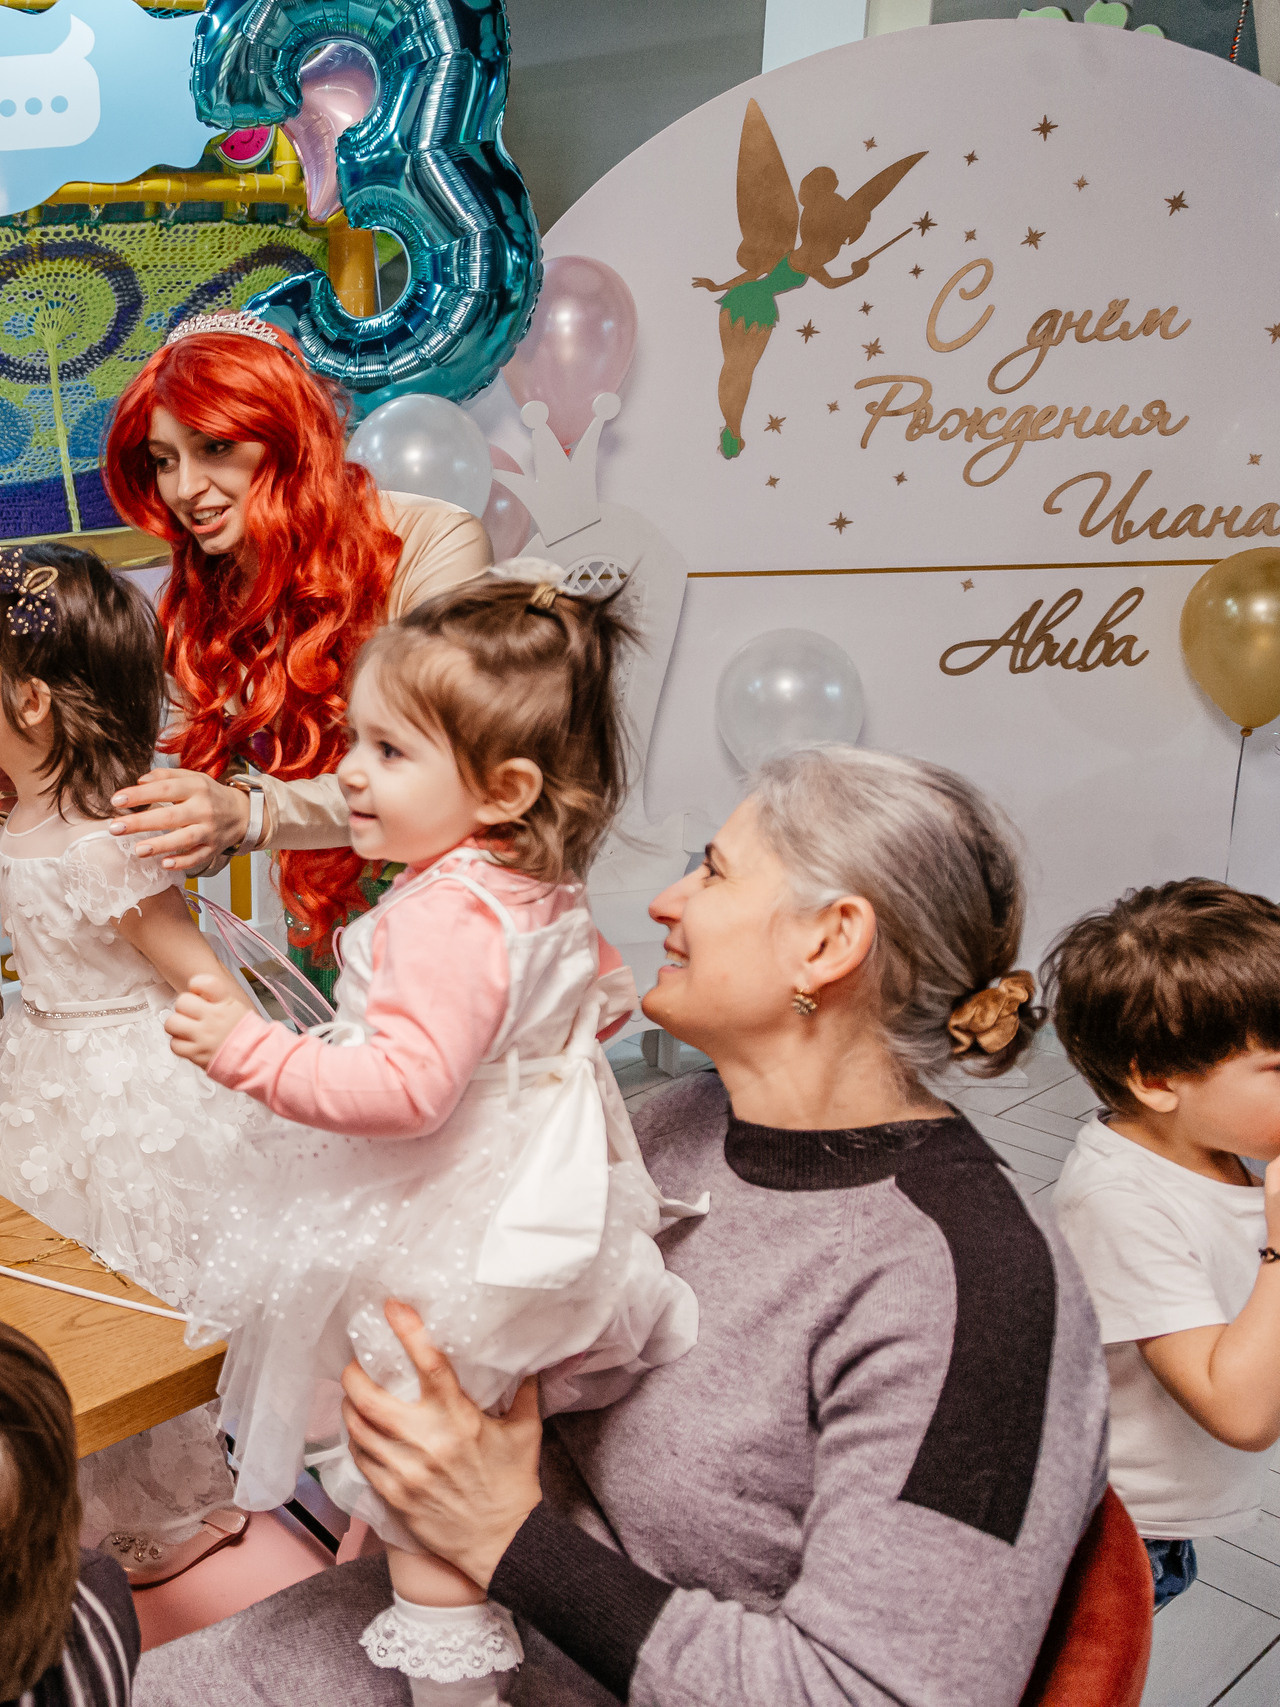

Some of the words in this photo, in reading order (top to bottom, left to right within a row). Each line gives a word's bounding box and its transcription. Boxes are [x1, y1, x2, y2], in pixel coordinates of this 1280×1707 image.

[190, 0, 544, 405] 3
[926, 257, 996, 353] С
[987, 298, 1192, 395] днём
[854, 374, 1190, 488] Рождения
[1042, 469, 1280, 545] Илана
[938, 586, 1150, 676] Авива
